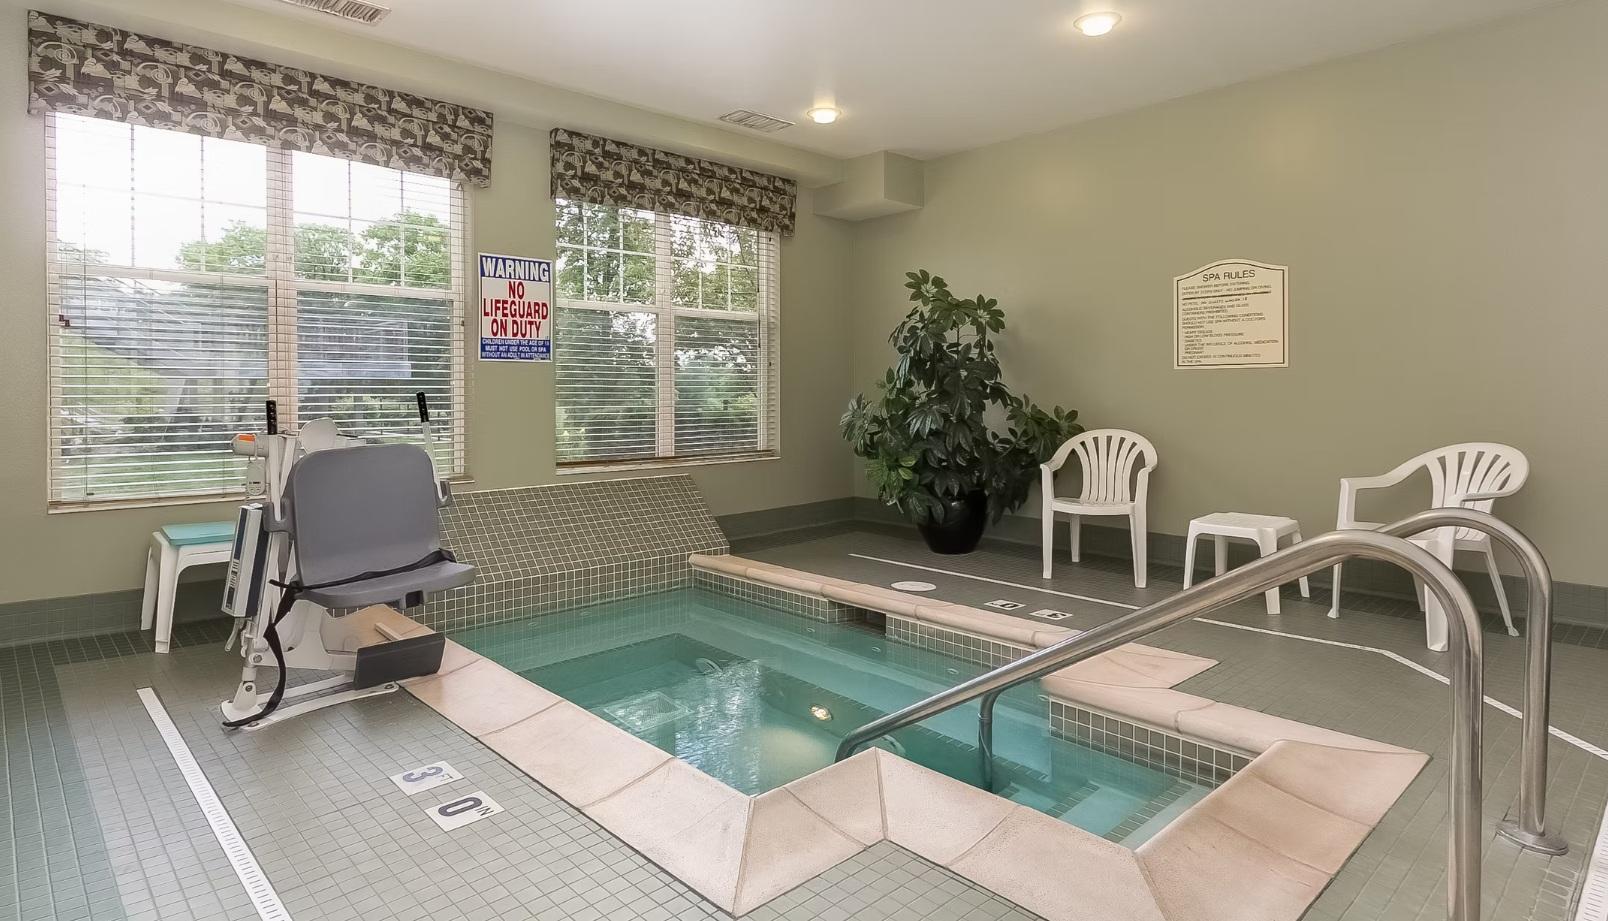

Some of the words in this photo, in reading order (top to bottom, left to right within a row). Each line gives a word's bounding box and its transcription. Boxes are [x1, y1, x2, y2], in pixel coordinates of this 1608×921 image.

[482, 257, 549, 282] WARNING
[1203, 273, 1220, 282] SPA
[1224, 270, 1255, 280] RULES
[508, 281, 524, 299] NO
[483, 298, 548, 320] LIFEGUARD
[491, 318, 507, 337] ON
[512, 320, 541, 338] DUTY
[402, 766, 444, 782] 3
[438, 797, 482, 817] 0
[475, 805, 494, 816] IN
